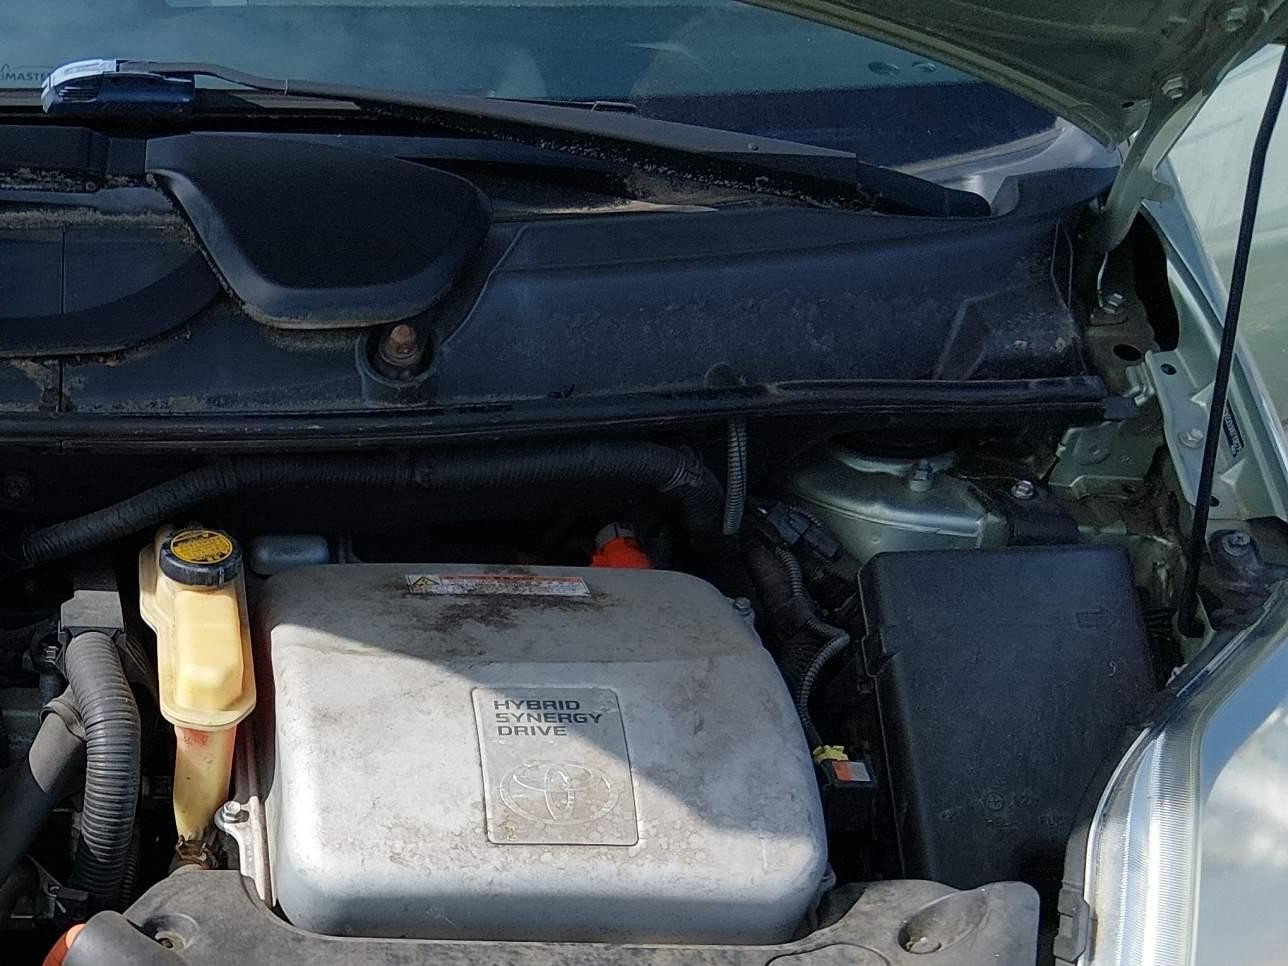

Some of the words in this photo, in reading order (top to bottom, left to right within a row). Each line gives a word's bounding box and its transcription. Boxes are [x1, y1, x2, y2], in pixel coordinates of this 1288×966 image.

[494, 700, 581, 711] HYBRID
[495, 713, 603, 724] SYNERGY
[498, 725, 567, 737] DRIVE
